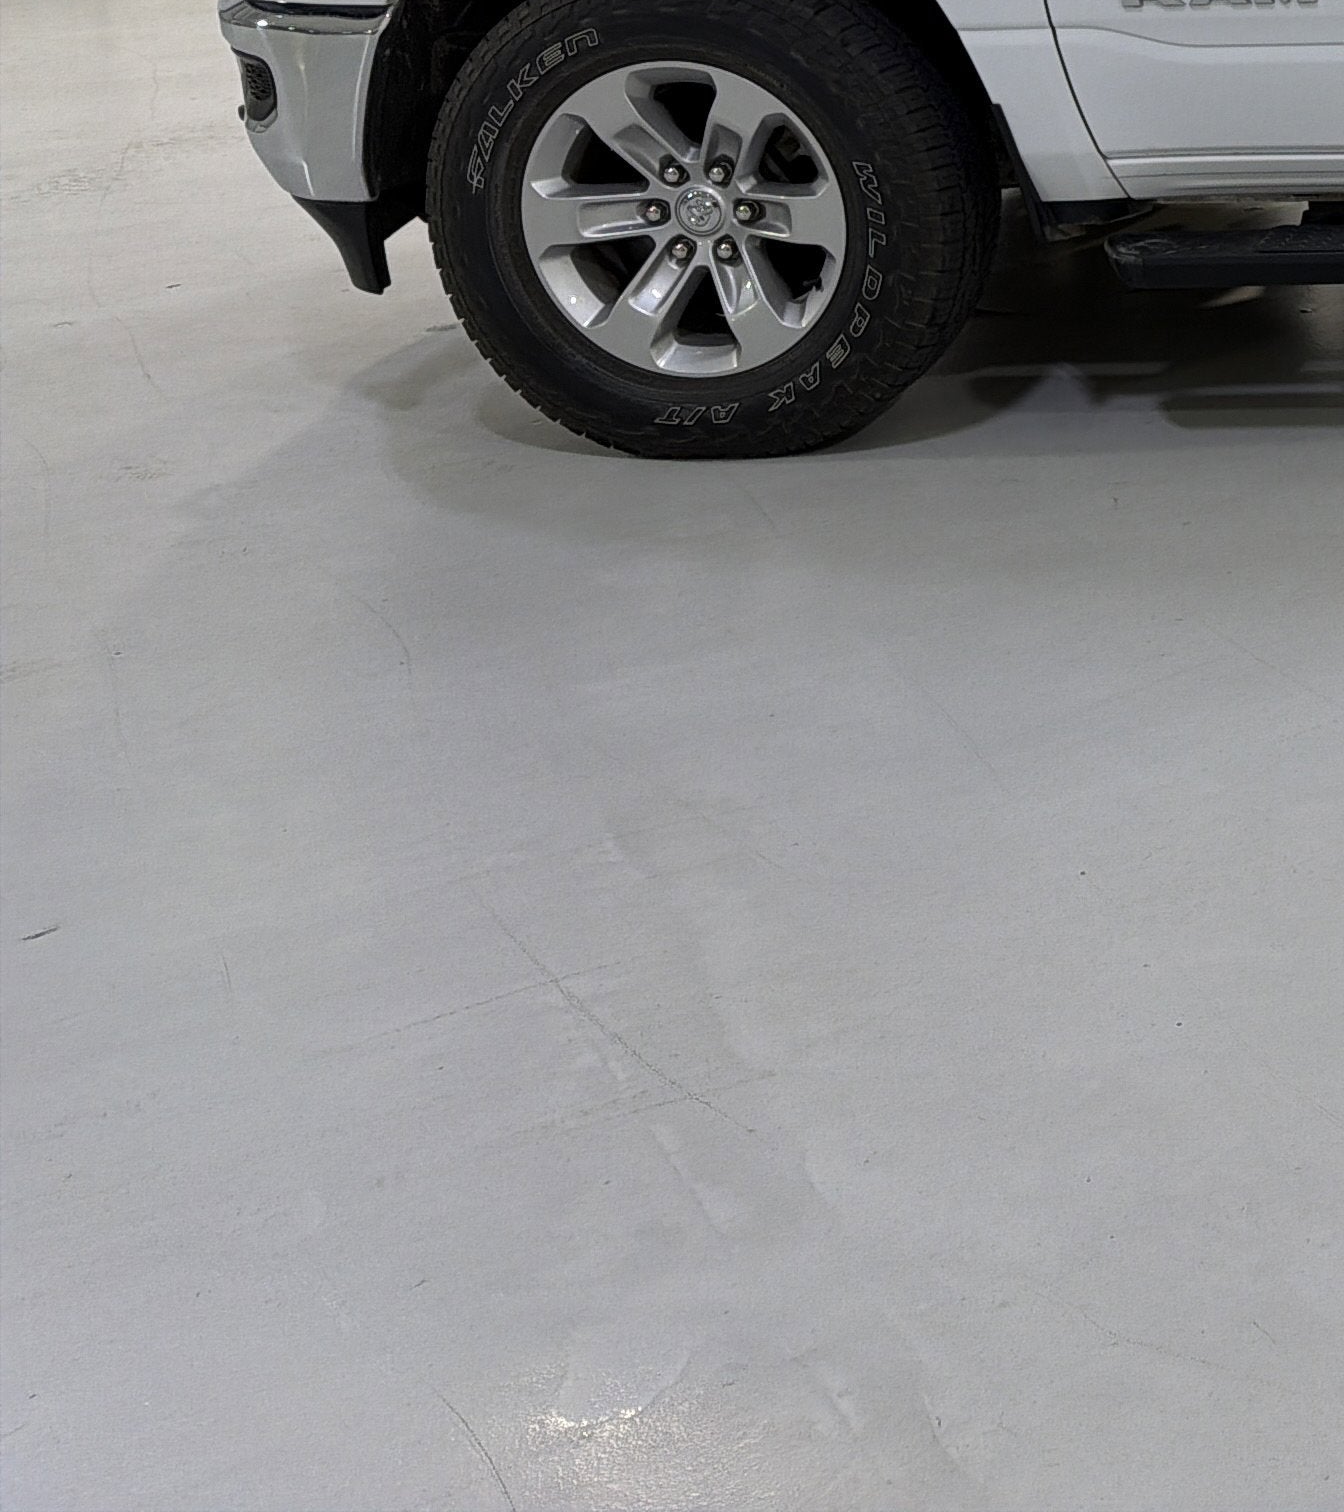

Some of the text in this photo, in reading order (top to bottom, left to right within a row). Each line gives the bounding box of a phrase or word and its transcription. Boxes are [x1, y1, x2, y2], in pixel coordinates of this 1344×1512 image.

[466, 28, 599, 194] FALKEN
[654, 161, 887, 426] WILDPEAK A/T
